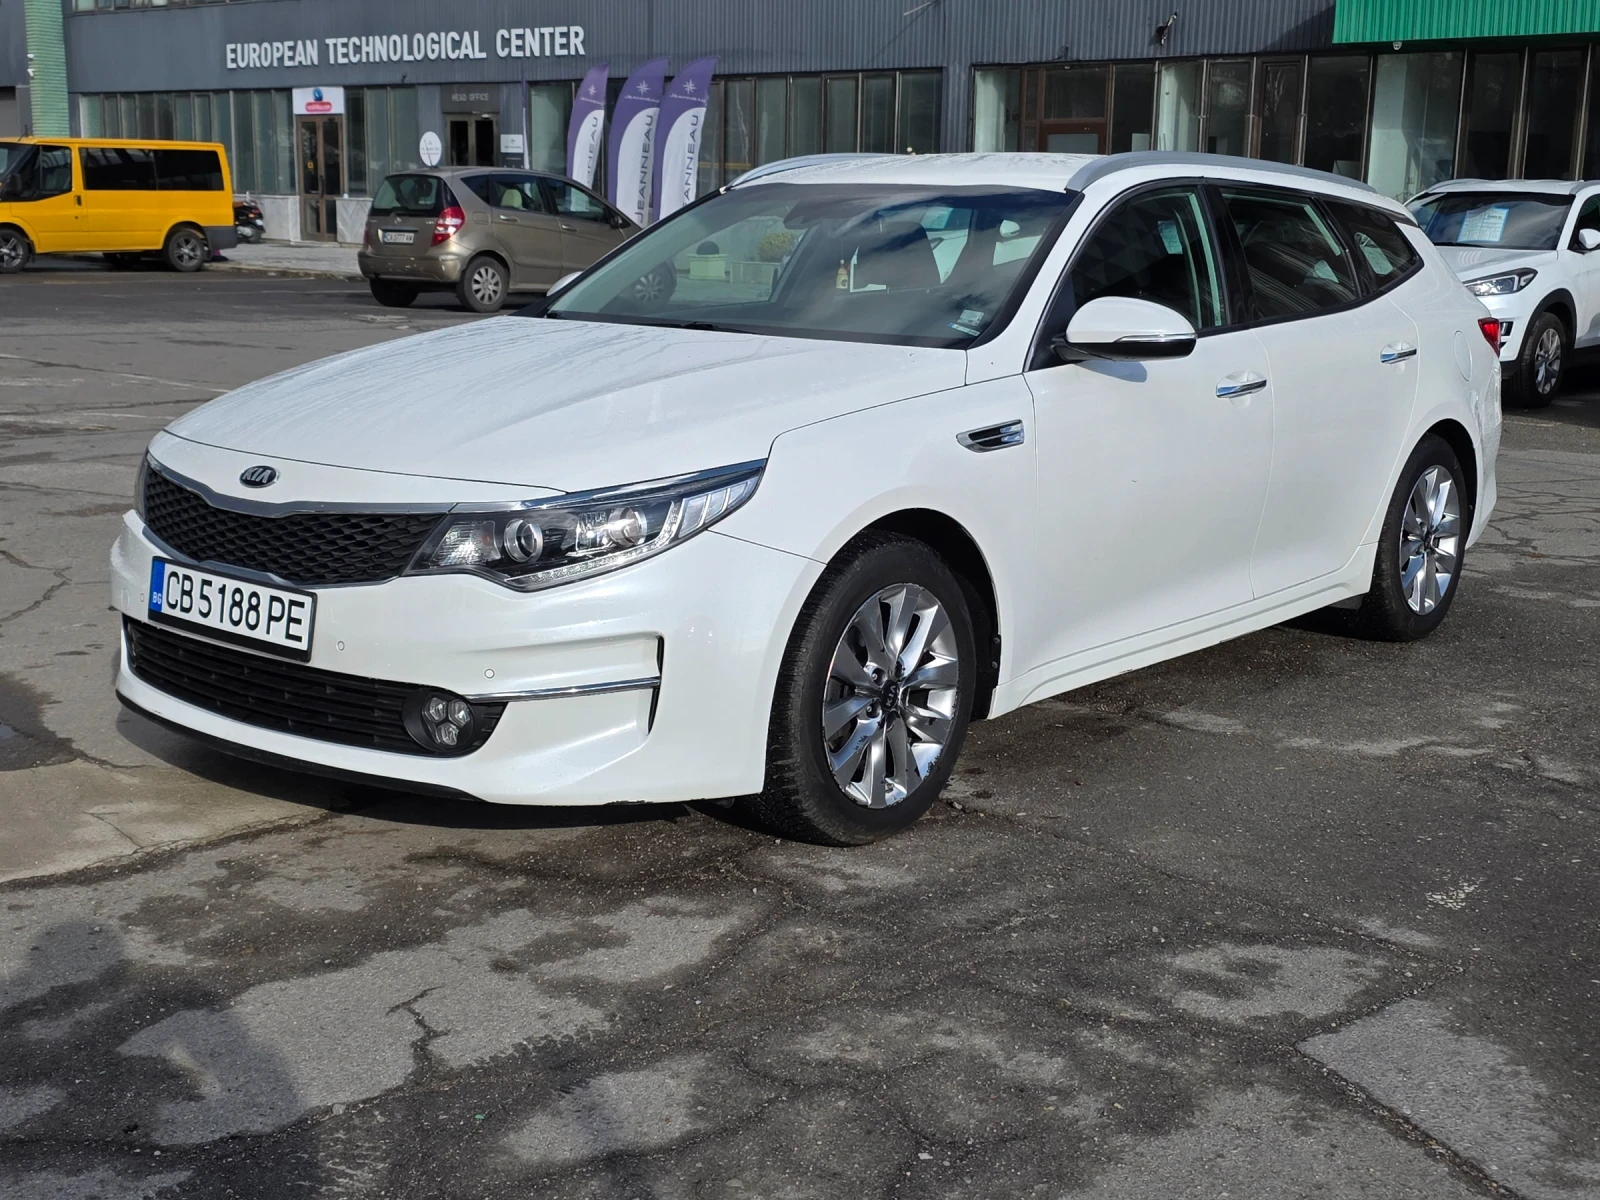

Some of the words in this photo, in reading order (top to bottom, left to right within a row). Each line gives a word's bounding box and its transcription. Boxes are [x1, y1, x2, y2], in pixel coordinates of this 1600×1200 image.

[226, 39, 319, 69] EUROPEAN
[325, 30, 487, 64] TECHNOLOGICAL
[496, 26, 586, 58] CENTER
[468, 93, 489, 101] OFFICE
[635, 115, 653, 223] JEANNEAU
[683, 115, 699, 206] ANNEAU
[242, 467, 272, 484] KIA
[152, 591, 162, 605] BG
[166, 571, 194, 613] CB
[198, 579, 261, 631] 5188
[266, 594, 305, 643] PE
[885, 685, 896, 707] KIA
